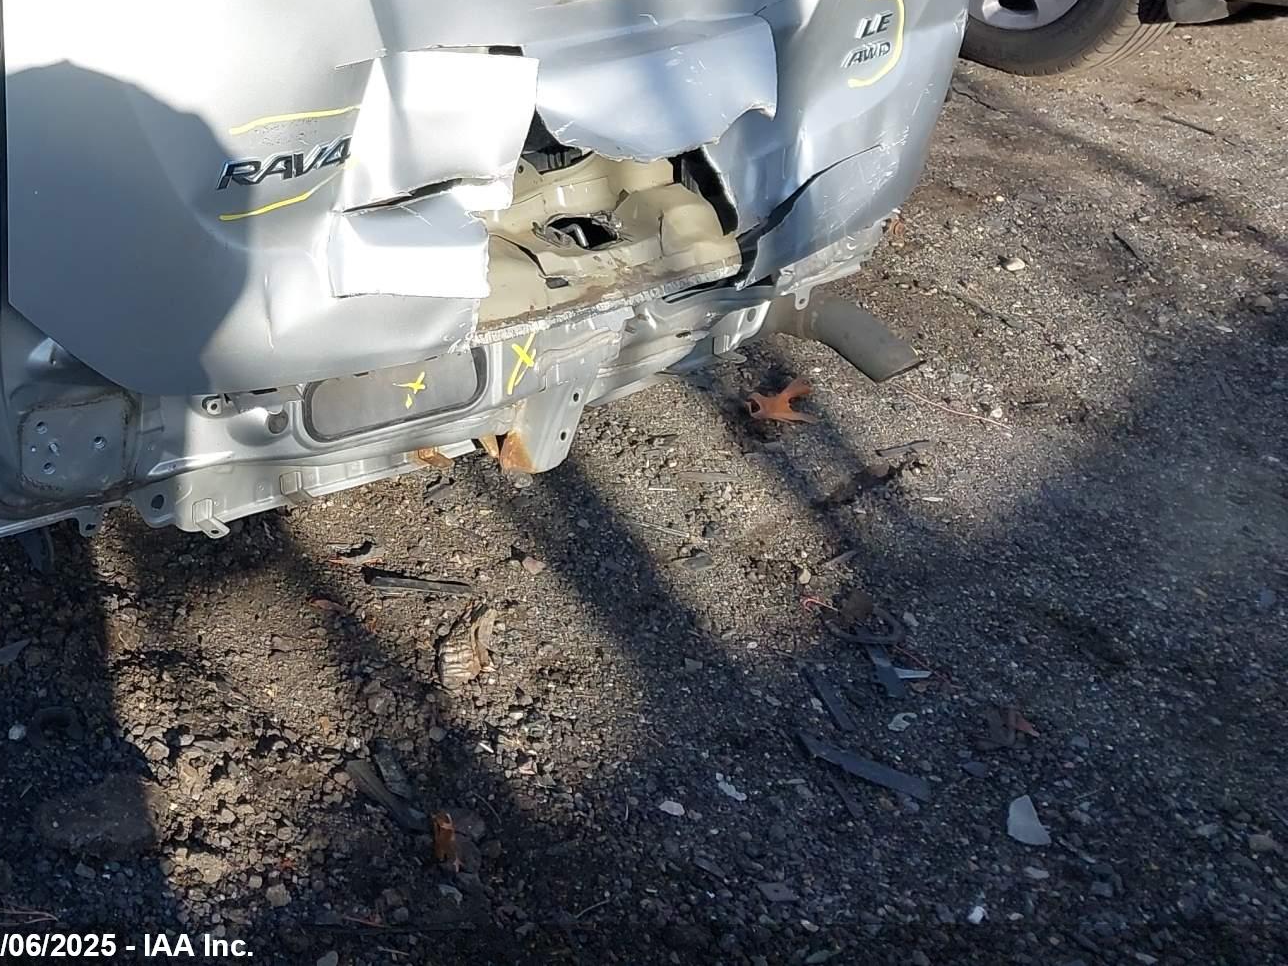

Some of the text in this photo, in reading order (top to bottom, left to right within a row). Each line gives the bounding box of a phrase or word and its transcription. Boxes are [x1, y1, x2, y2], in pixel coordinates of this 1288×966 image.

[855, 10, 893, 39] LE
[841, 40, 891, 68] AWD
[216, 134, 354, 190] RAV4
